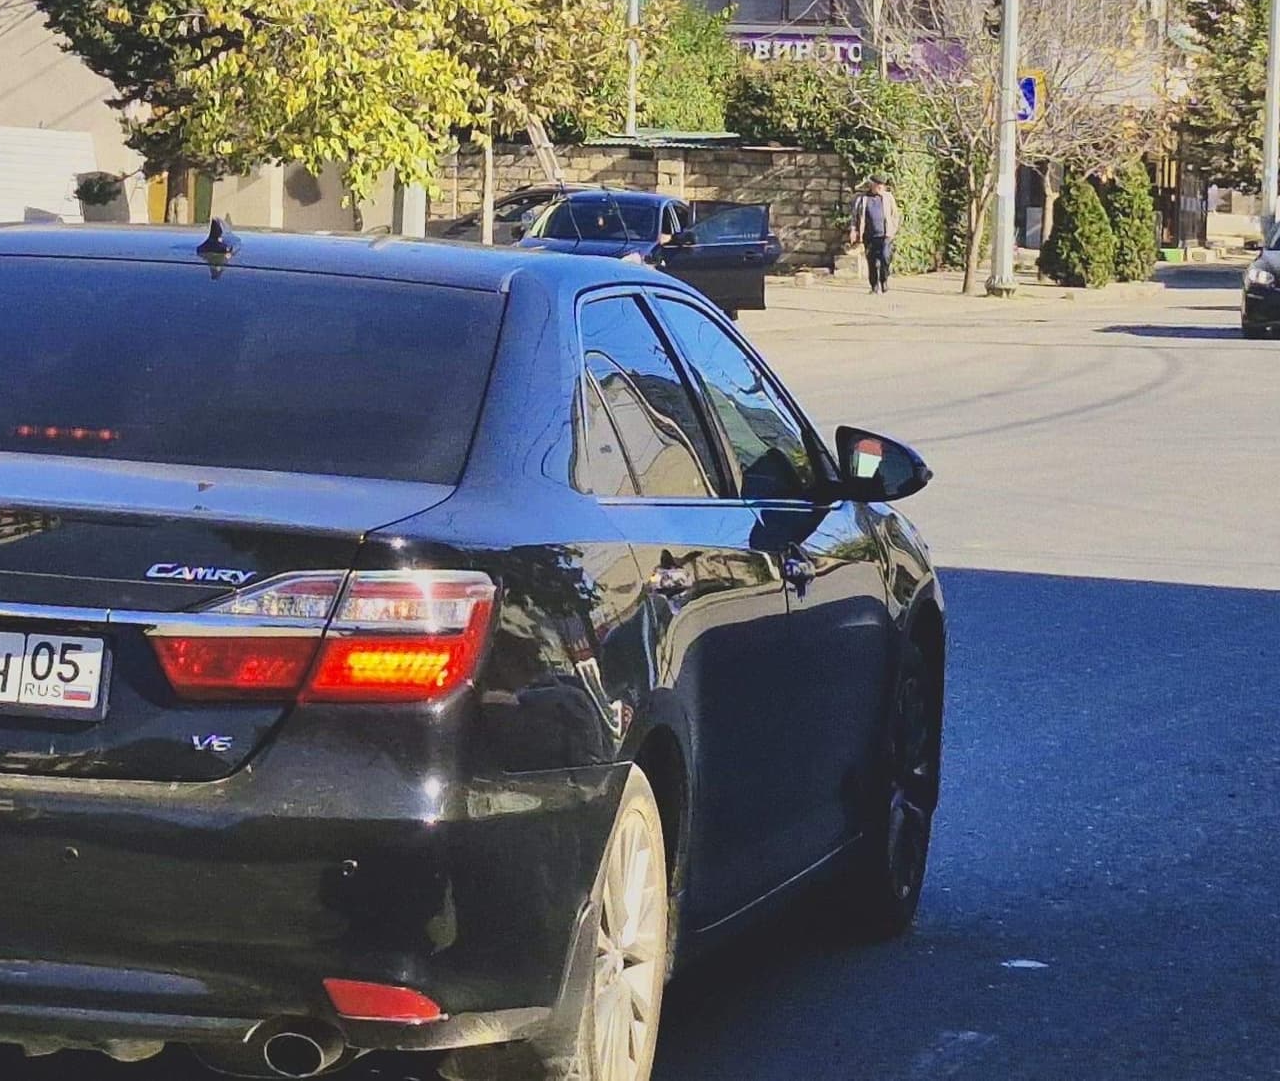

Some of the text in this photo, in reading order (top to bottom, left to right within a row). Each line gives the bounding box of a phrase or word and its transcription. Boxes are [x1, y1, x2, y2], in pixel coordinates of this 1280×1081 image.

[146, 563, 257, 585] CAMRY
[31, 641, 84, 683] 05
[25, 682, 62, 698] RUS
[192, 734, 233, 751] V6
